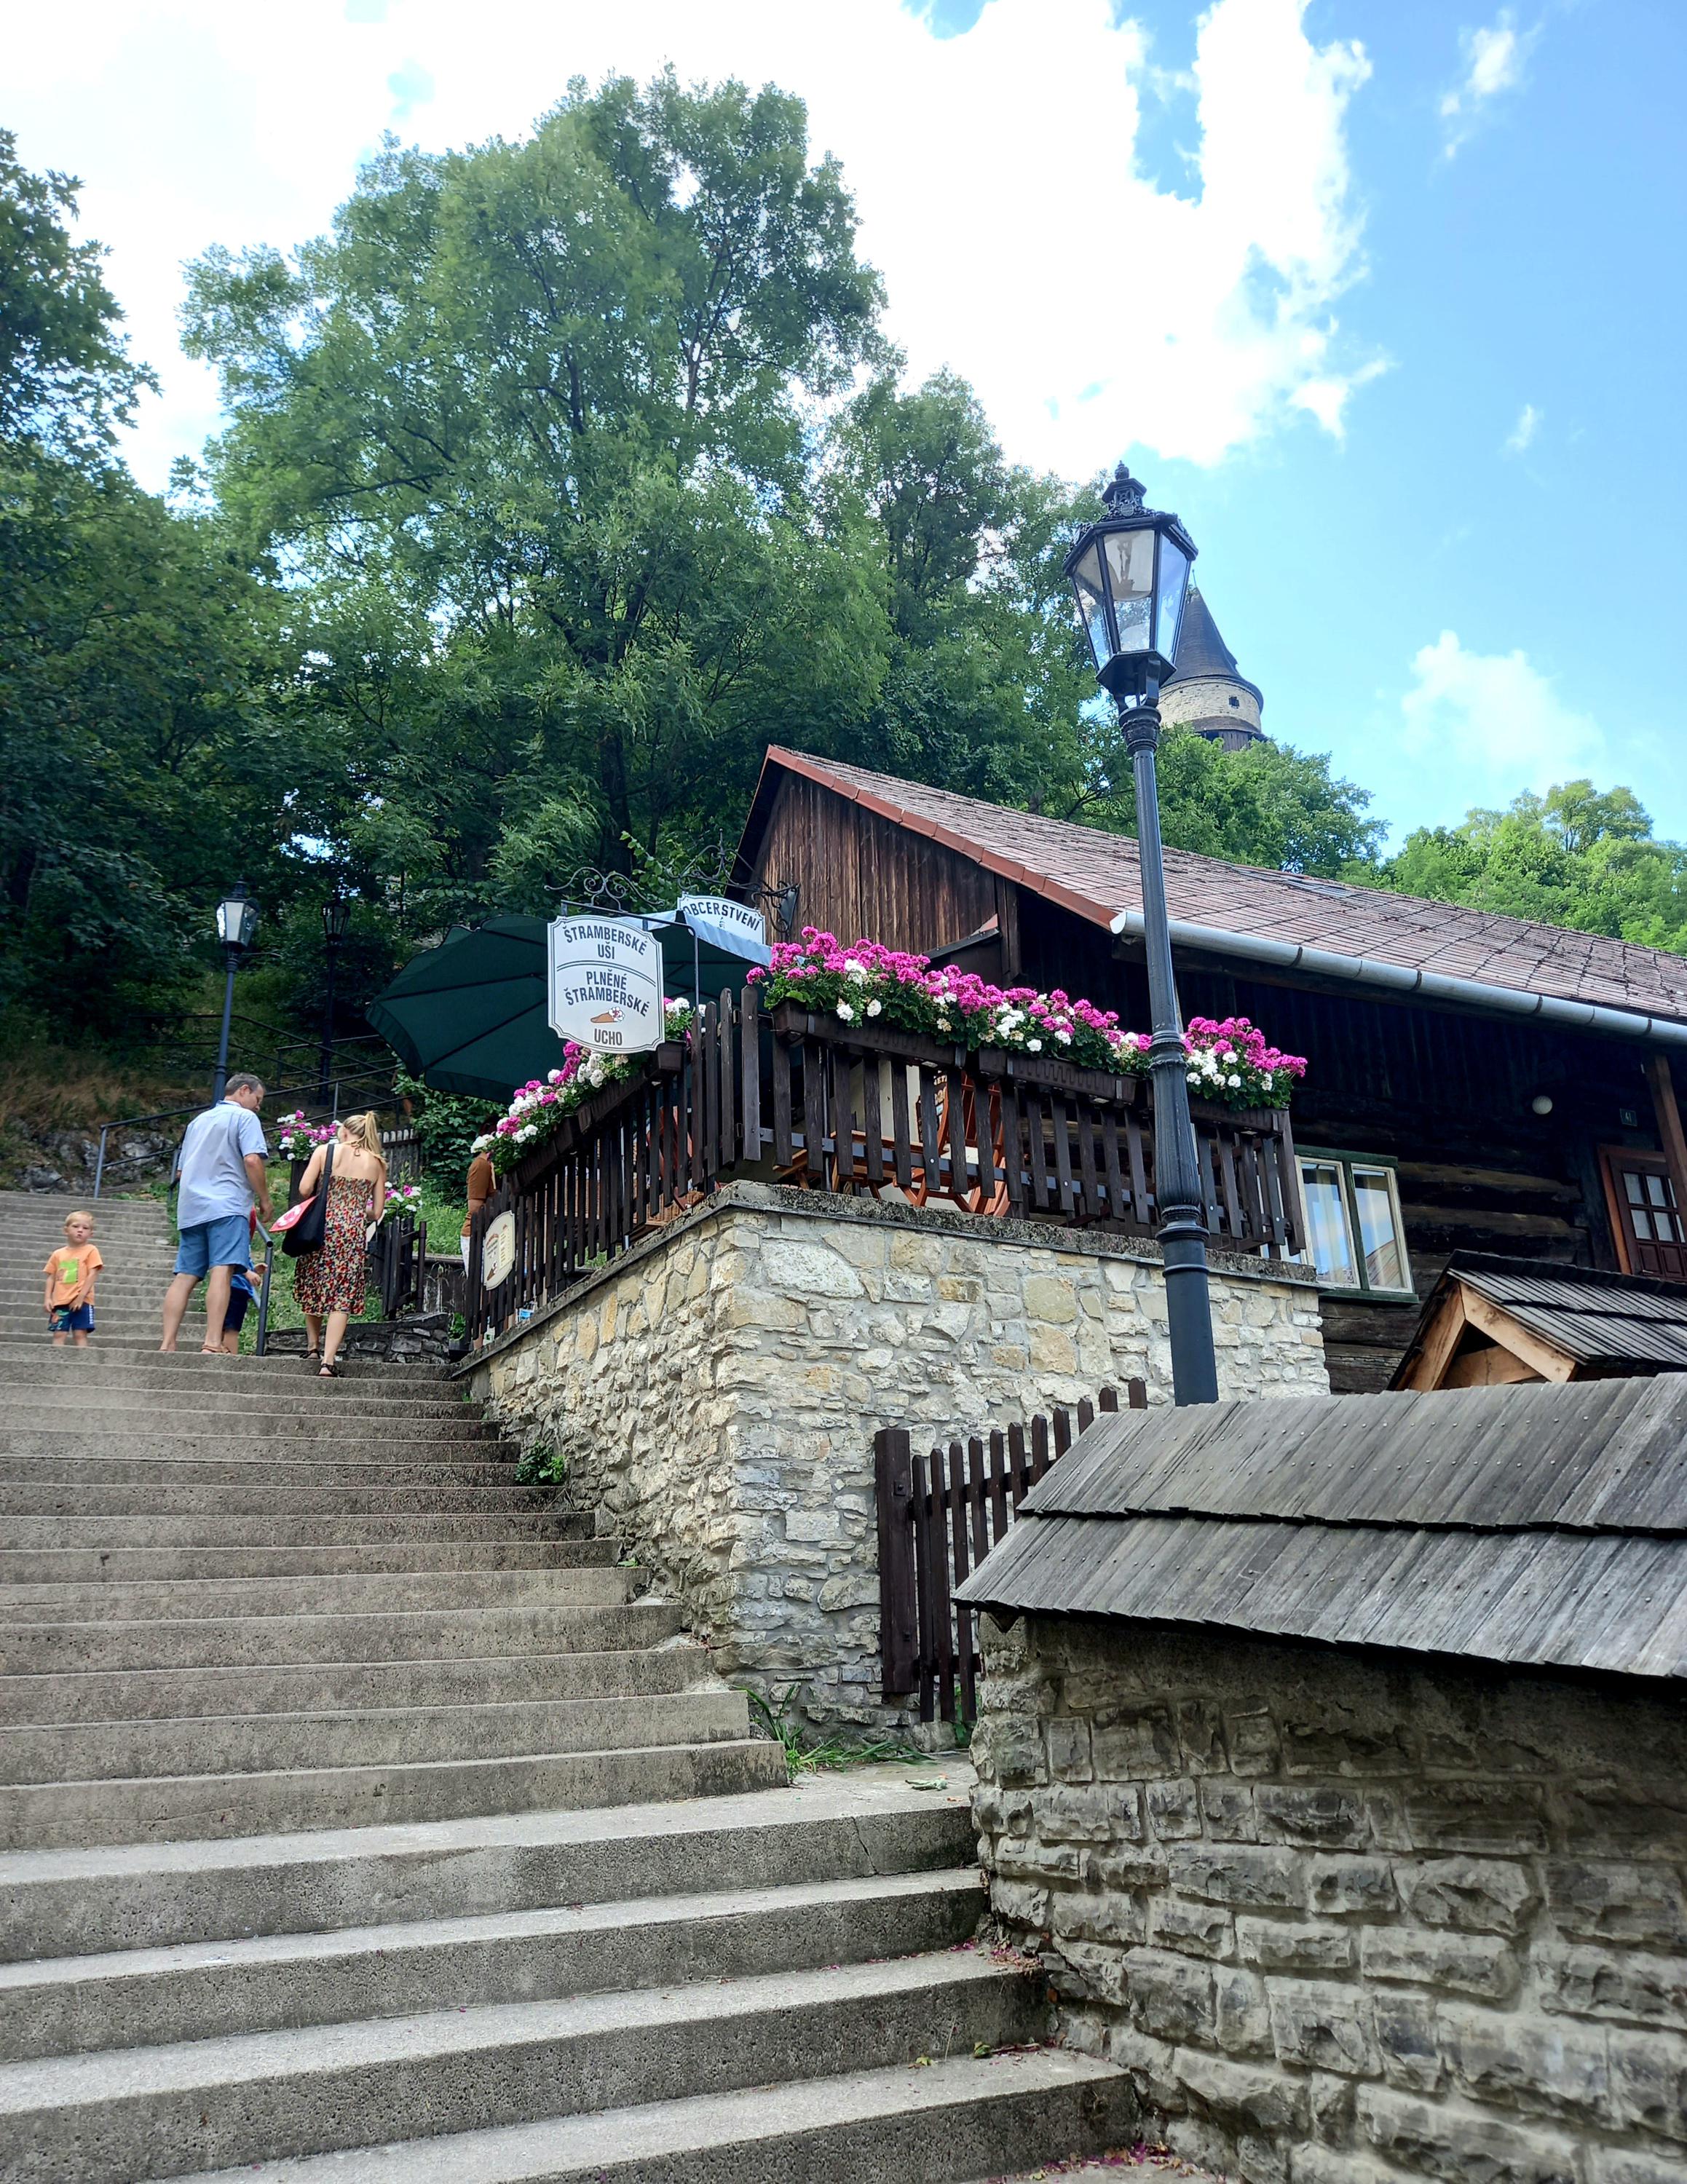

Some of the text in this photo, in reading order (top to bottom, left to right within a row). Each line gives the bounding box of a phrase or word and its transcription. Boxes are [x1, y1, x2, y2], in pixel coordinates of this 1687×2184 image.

[563, 925, 647, 955] ŠTRAMBERSKÉ
[598, 941, 615, 960] UŠI
[586, 969, 627, 990] PLNĚNÉ
[564, 987, 650, 1017] ŠTRAMBERSKÉ
[594, 1028, 623, 1046] UCHO
